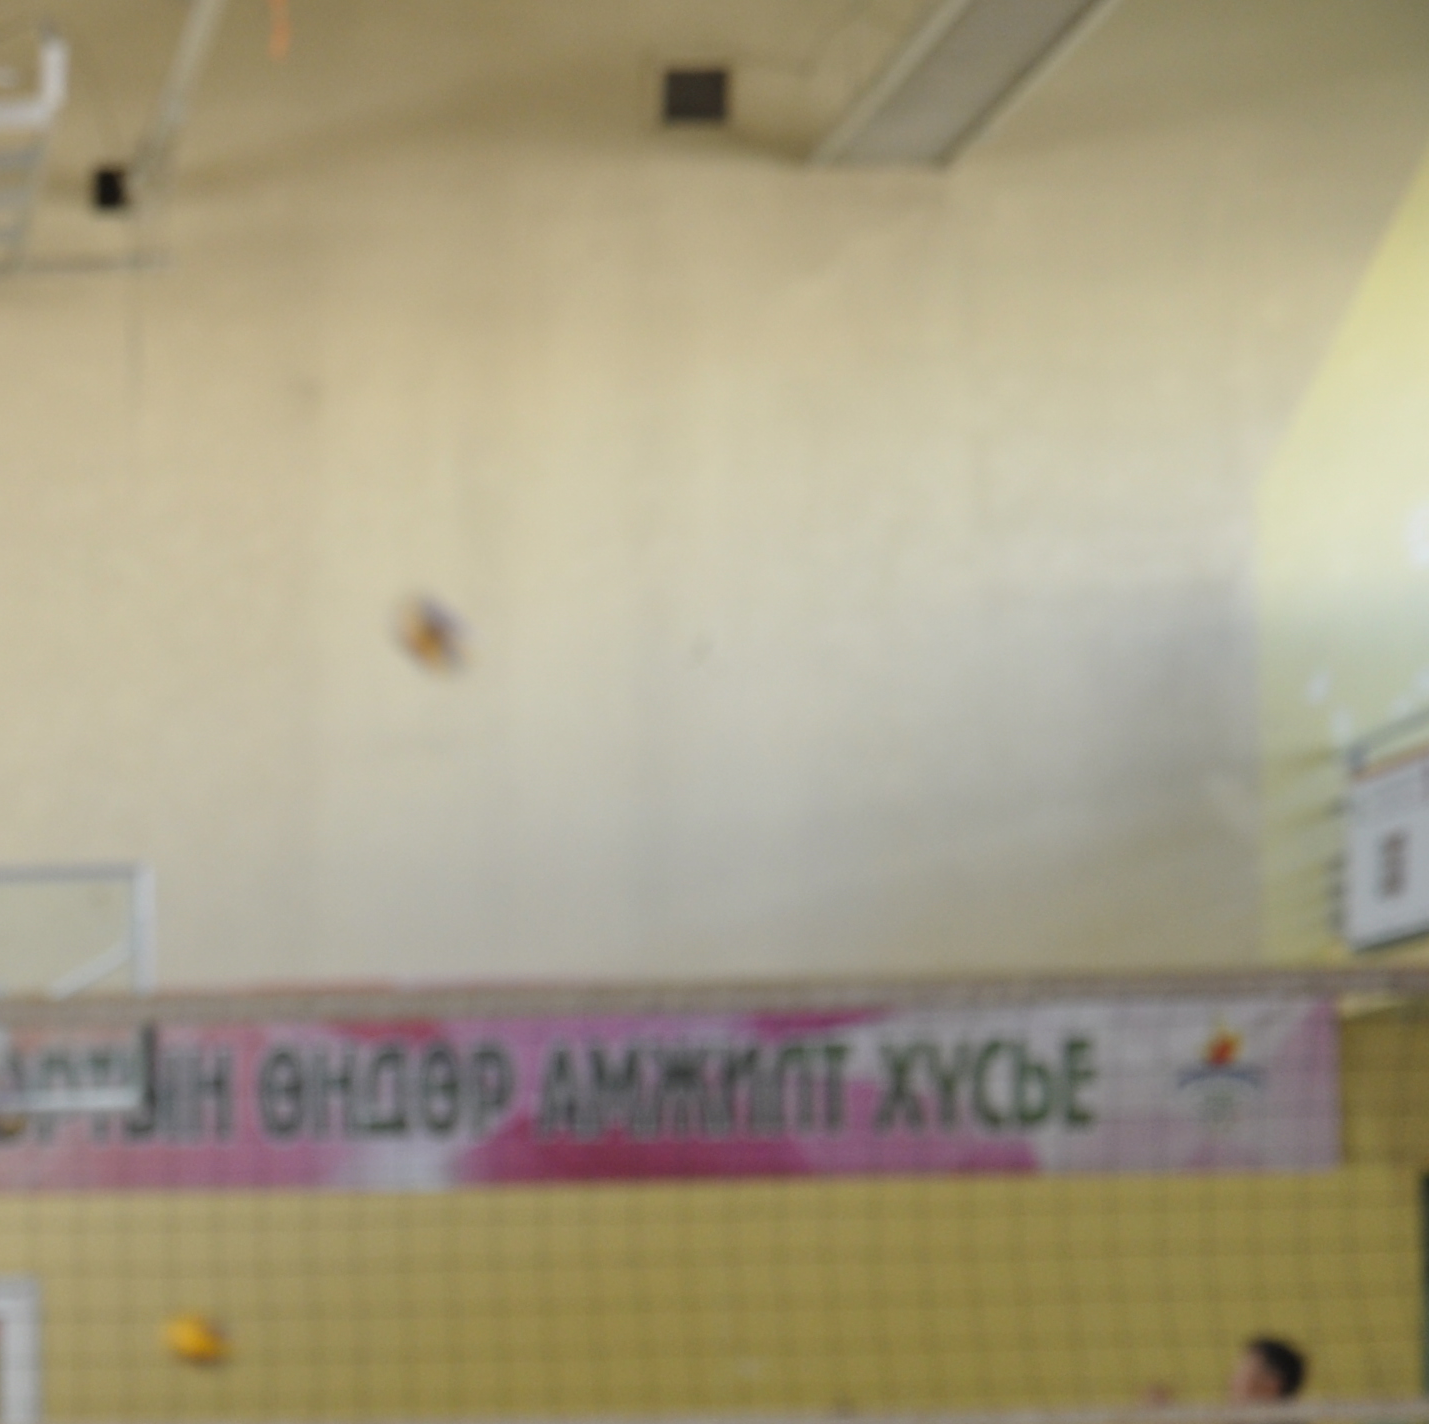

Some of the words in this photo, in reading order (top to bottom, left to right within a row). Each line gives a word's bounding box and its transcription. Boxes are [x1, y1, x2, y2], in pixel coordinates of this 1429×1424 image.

[257, 1040, 515, 1145] ӨНДӨР
[537, 1038, 853, 1142] АМЖИЛТ
[874, 1034, 1101, 1135] ХҮСЬЕ
